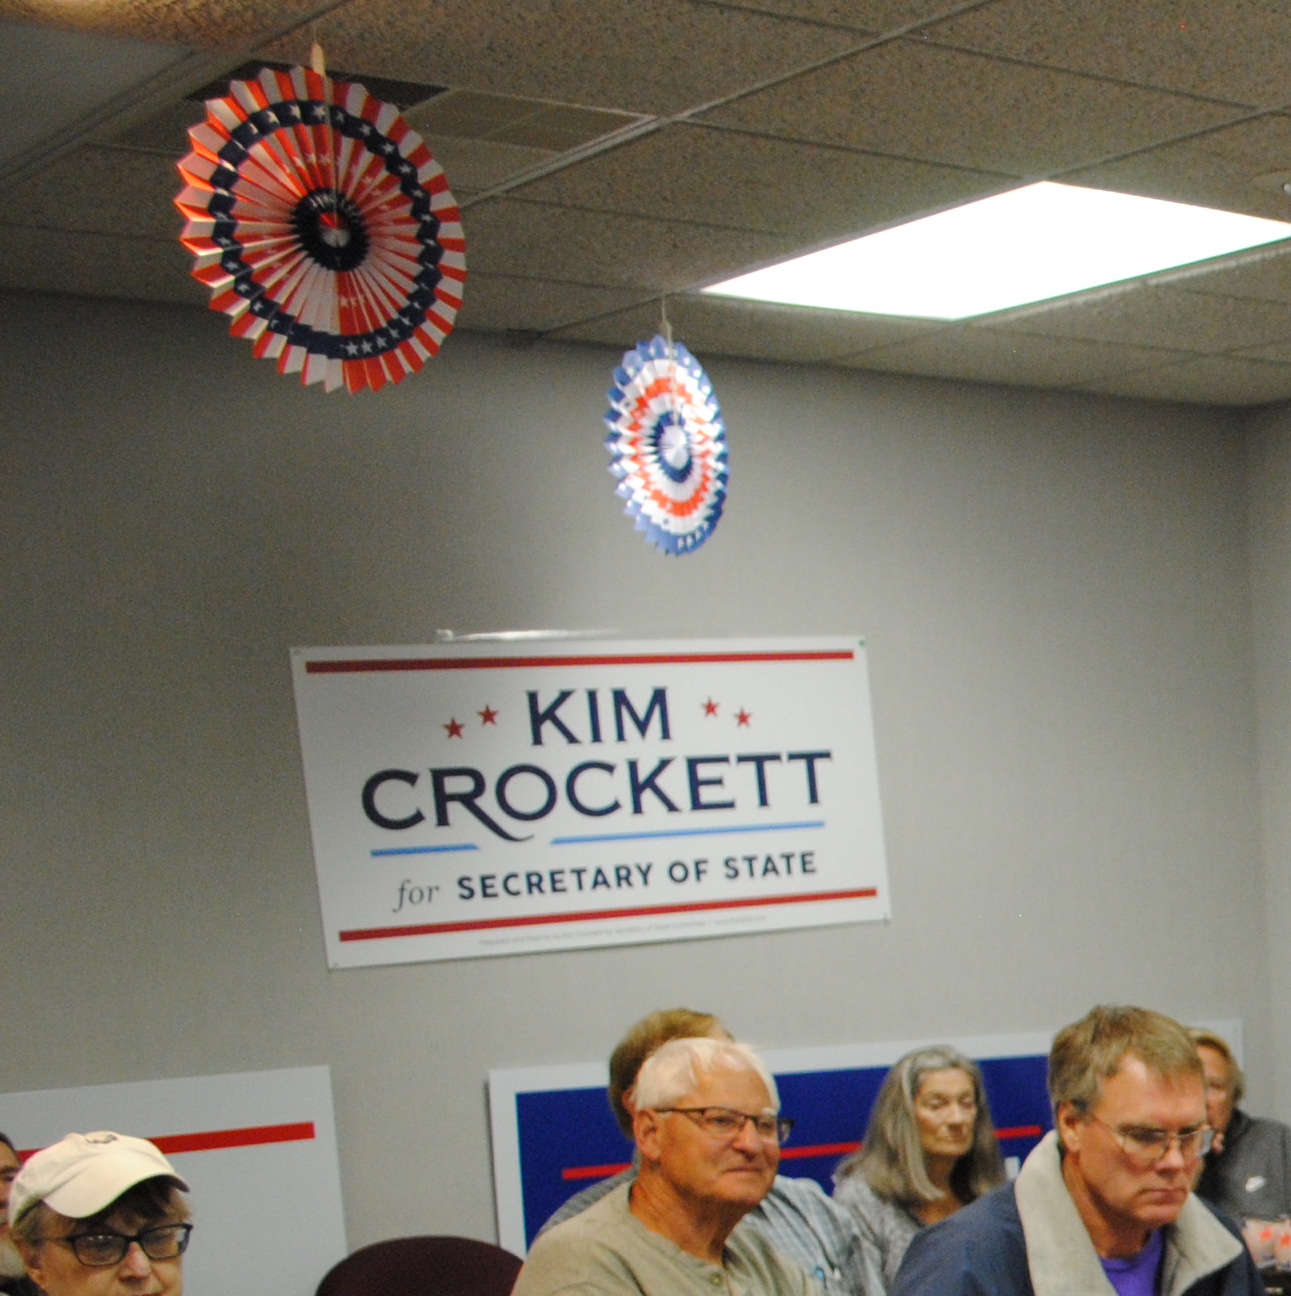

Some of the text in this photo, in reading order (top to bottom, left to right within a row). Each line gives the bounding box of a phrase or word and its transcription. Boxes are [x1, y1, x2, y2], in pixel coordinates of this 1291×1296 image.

[526, 686, 673, 746] KIM
[361, 750, 832, 841] CROCKETT
[393, 851, 818, 913] for SECRETARY OF STATE
